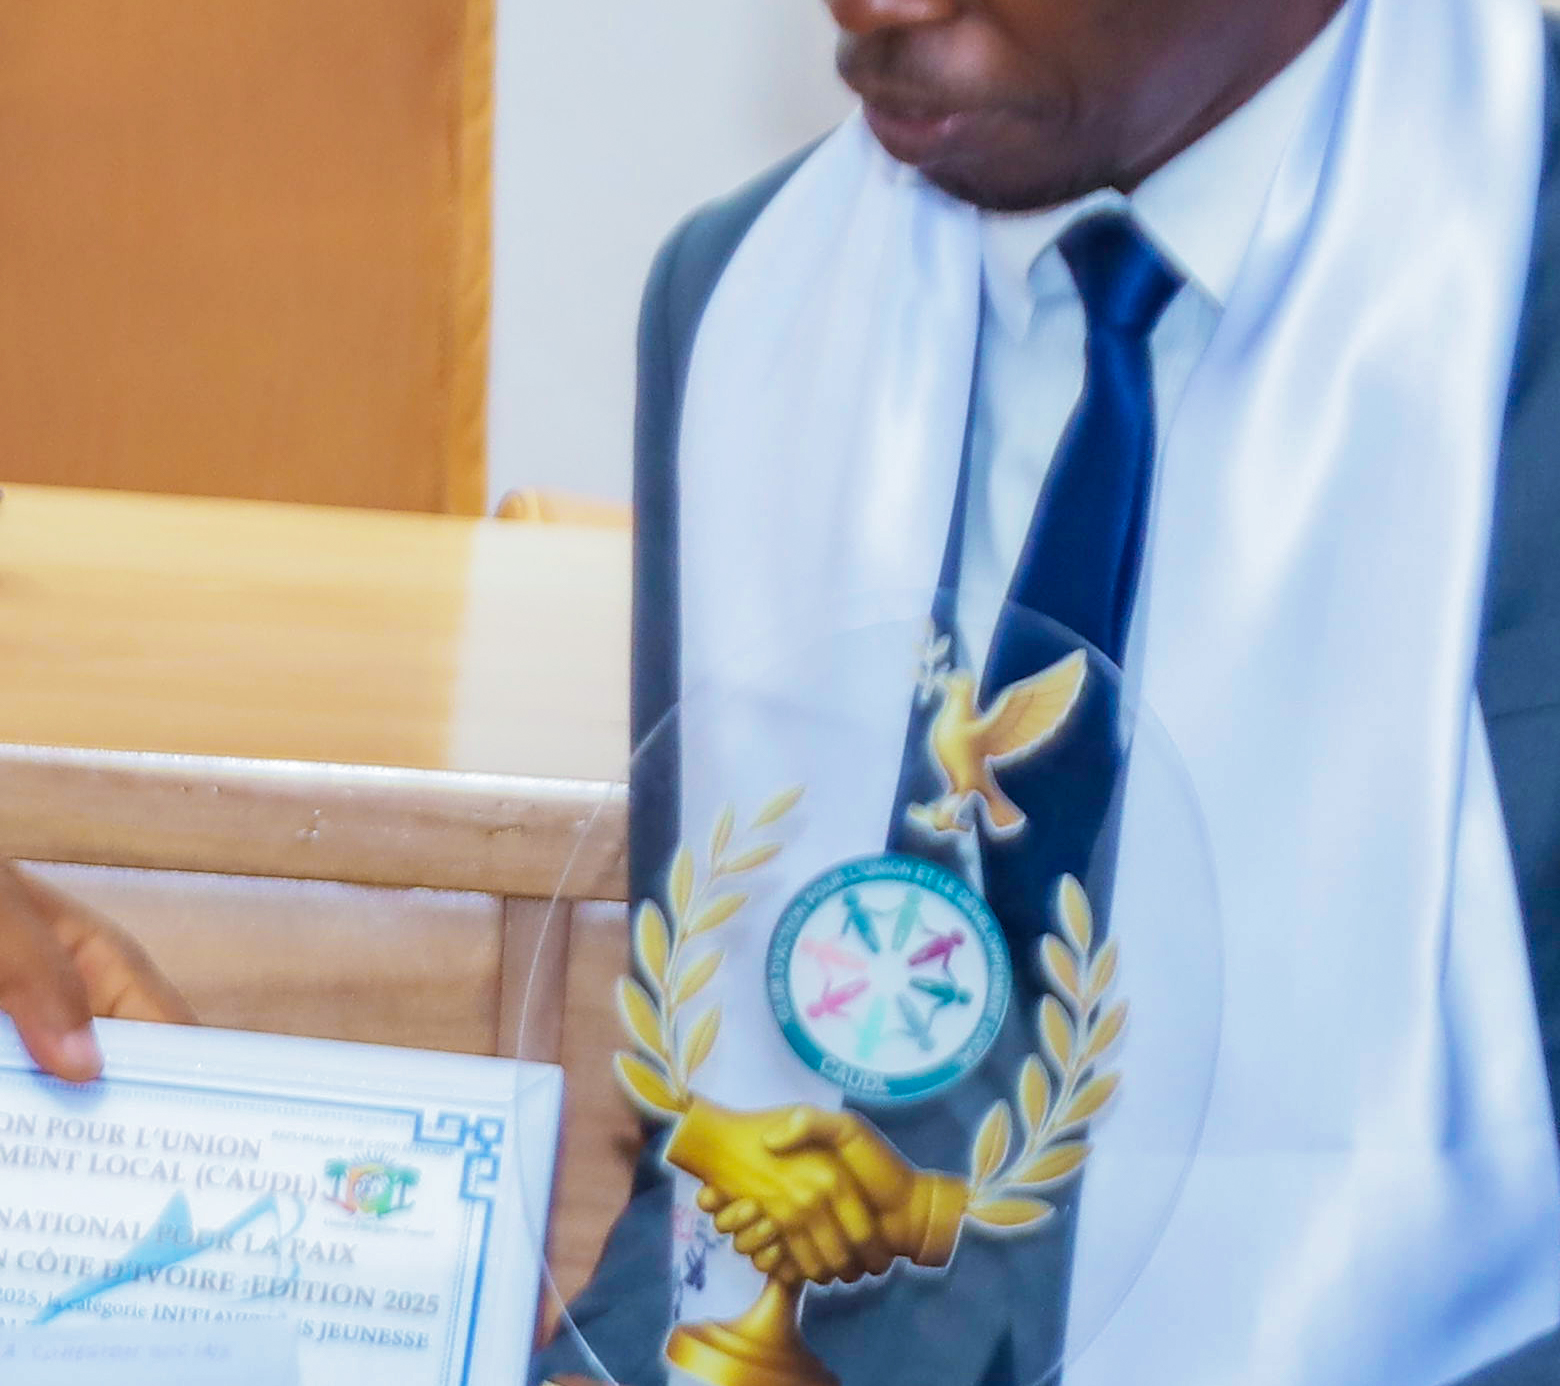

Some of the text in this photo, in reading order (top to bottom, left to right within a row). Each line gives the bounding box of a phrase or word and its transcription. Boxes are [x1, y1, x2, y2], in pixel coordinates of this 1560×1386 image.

[47, 1115, 125, 1145] POUR
[134, 1127, 262, 1160] L'UNION
[88, 1152, 185, 1184] LOCAL
[196, 1164, 318, 1202] (CAUDL)
[156, 1223, 234, 1253] POUR
[244, 1233, 279, 1256] LA
[289, 1237, 359, 1264] PAIX
[16, 1246, 94, 1278] CÔTE
[383, 1289, 441, 1314] 2025
[317, 1320, 430, 1352] JEUNESSE
